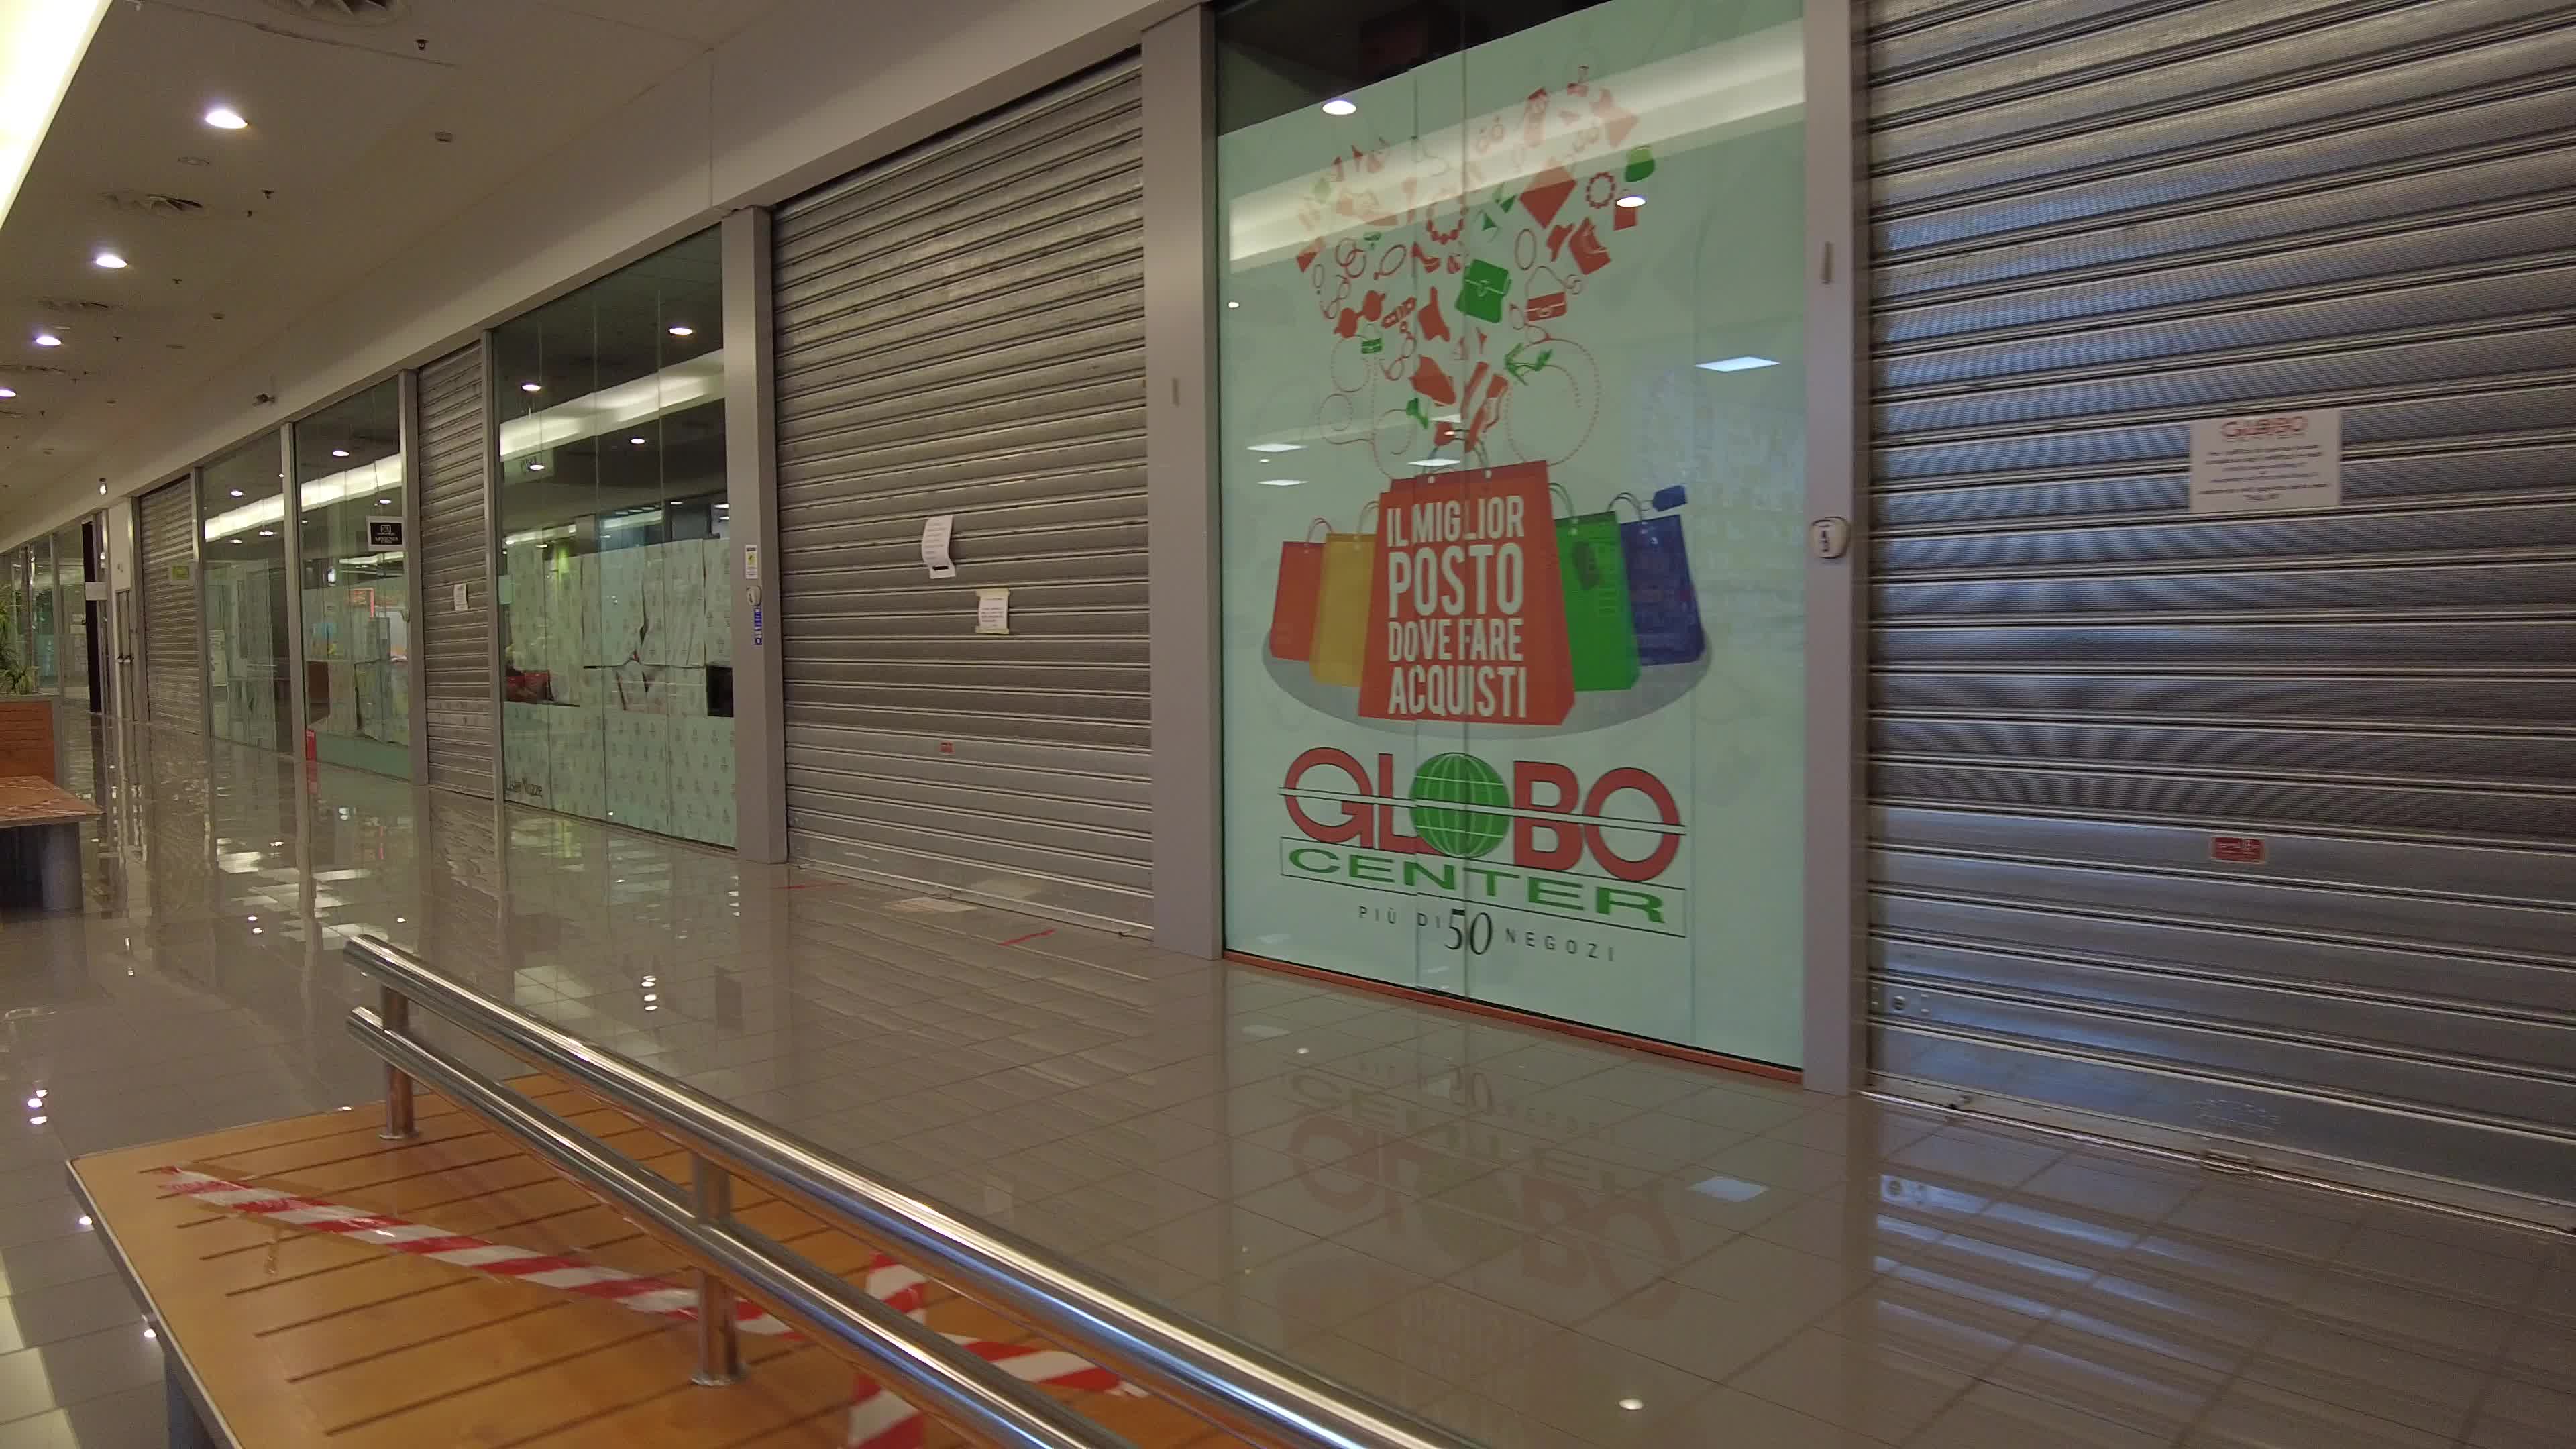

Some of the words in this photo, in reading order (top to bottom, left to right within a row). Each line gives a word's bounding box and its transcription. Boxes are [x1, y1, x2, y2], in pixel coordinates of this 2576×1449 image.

[1387, 508, 1409, 547] IL
[1411, 496, 1524, 543] MIGLIOR
[1388, 542, 1524, 618] POSTO
[1388, 619, 1452, 661] DOVE
[1458, 618, 1524, 661] FARE
[1388, 665, 1527, 718] ACQUISTI
[1283, 747, 1681, 882] GLOBO
[1288, 847, 1666, 924] CENTER
[1358, 905, 1397, 924] PIÙ
[1417, 912, 1441, 929] DI
[1444, 908, 1493, 955] 50
[1505, 928, 1616, 962] NEGOZI
